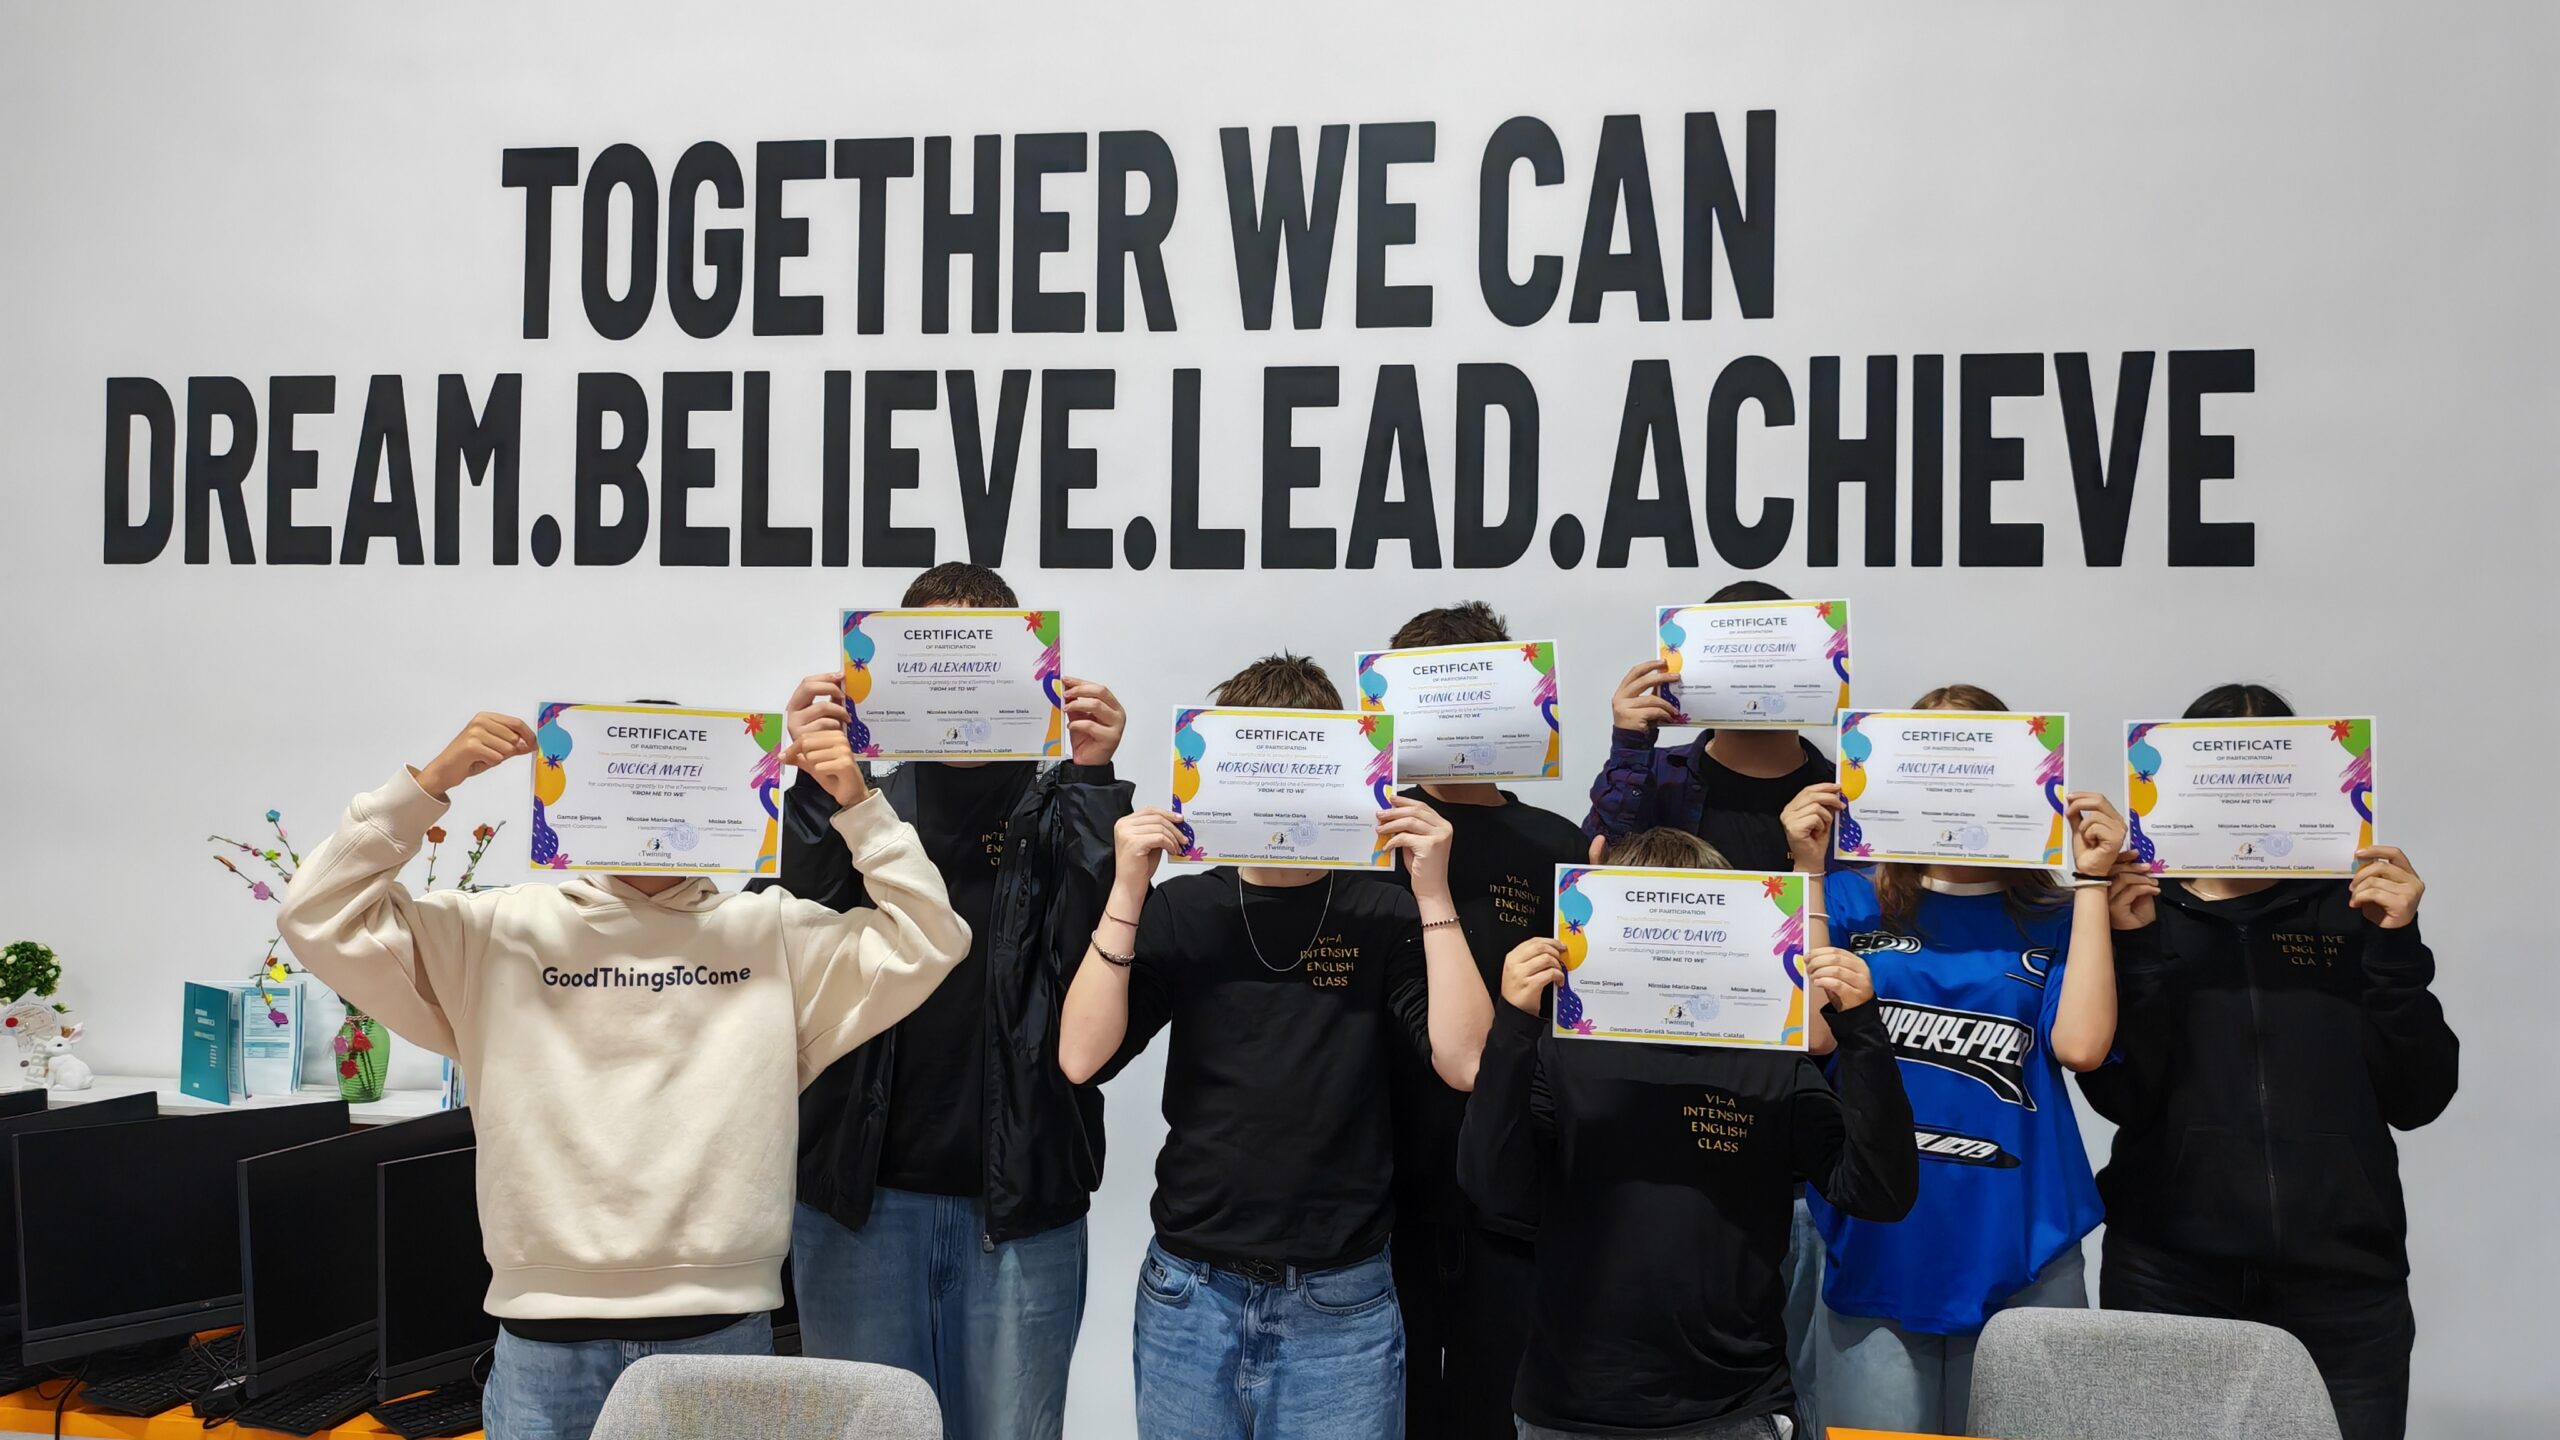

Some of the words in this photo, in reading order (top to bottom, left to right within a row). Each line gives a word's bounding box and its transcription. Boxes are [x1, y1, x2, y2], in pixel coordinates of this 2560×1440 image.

[502, 131, 1178, 340] TOGETHER
[1220, 121, 1436, 330] WE
[1479, 110, 1776, 326] CAN
[1710, 616, 1788, 628] CERTIFICATE
[903, 629, 993, 640] CERTIFICATE
[1702, 643, 1752, 654] POPESCU
[896, 662, 927, 673] VLAD
[929, 661, 1001, 672] ALEXANDRU
[1412, 660, 1493, 675] CERTIFICATE
[1455, 689, 1491, 701] LUCAS
[606, 726, 707, 741] CERTIFICATE
[1235, 728, 1325, 741] CERTIFICATE
[1901, 730, 1993, 742] CERTIFICATE
[2192, 739, 2292, 752] CERTIFICATE
[1290, 763, 1341, 775] ROBERT
[2192, 773, 2235, 785] LUCAN
[1489, 884, 1541, 904] INTENSIVE
[1625, 890, 1725, 905] CERTIFICATE
[1495, 897, 1536, 916] ENGLISH
[1499, 912, 1529, 927] CLASS
[1622, 926, 1680, 940] BONDOC
[2271, 933, 2345, 944] INTENIVE
[1300, 947, 1360, 959] INTENSIVE
[1306, 961, 1354, 972] ENGLISH
[542, 965, 751, 992] GoodThingsToCome
[1312, 976, 1349, 986] CLASS
[1683, 1106, 1755, 1125] INTENSIVE
[1691, 1121, 1748, 1138] ENGLISH
[1697, 1137, 1739, 1153] CLASS
